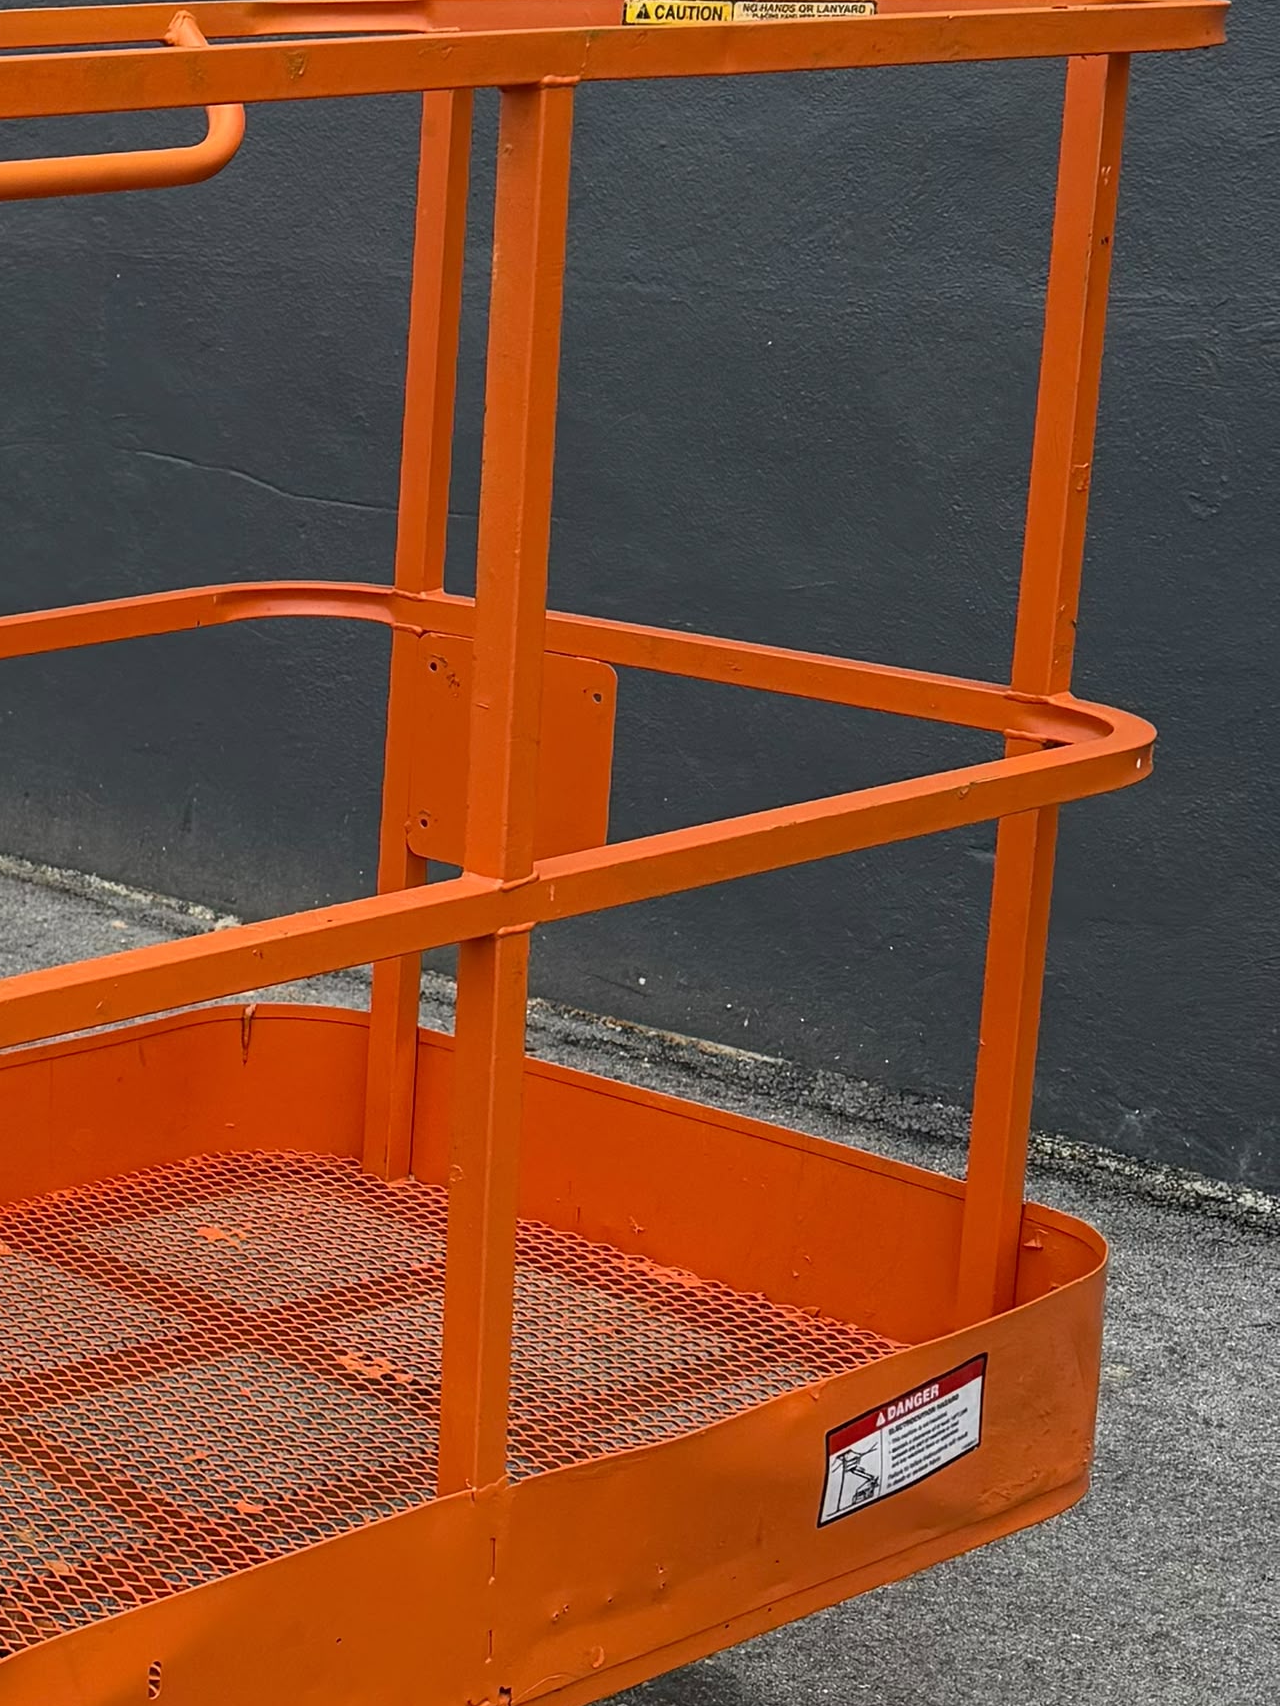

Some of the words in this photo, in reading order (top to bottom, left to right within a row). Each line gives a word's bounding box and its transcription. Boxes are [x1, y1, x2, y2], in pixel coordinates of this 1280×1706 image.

[654, 4, 724, 21] CAUTION
[742, 3, 757, 13] NO
[759, 4, 796, 13] HANDS
[798, 4, 814, 14] OR
[816, 4, 866, 14] LANYARD
[887, 1384, 939, 1421] DANGER
